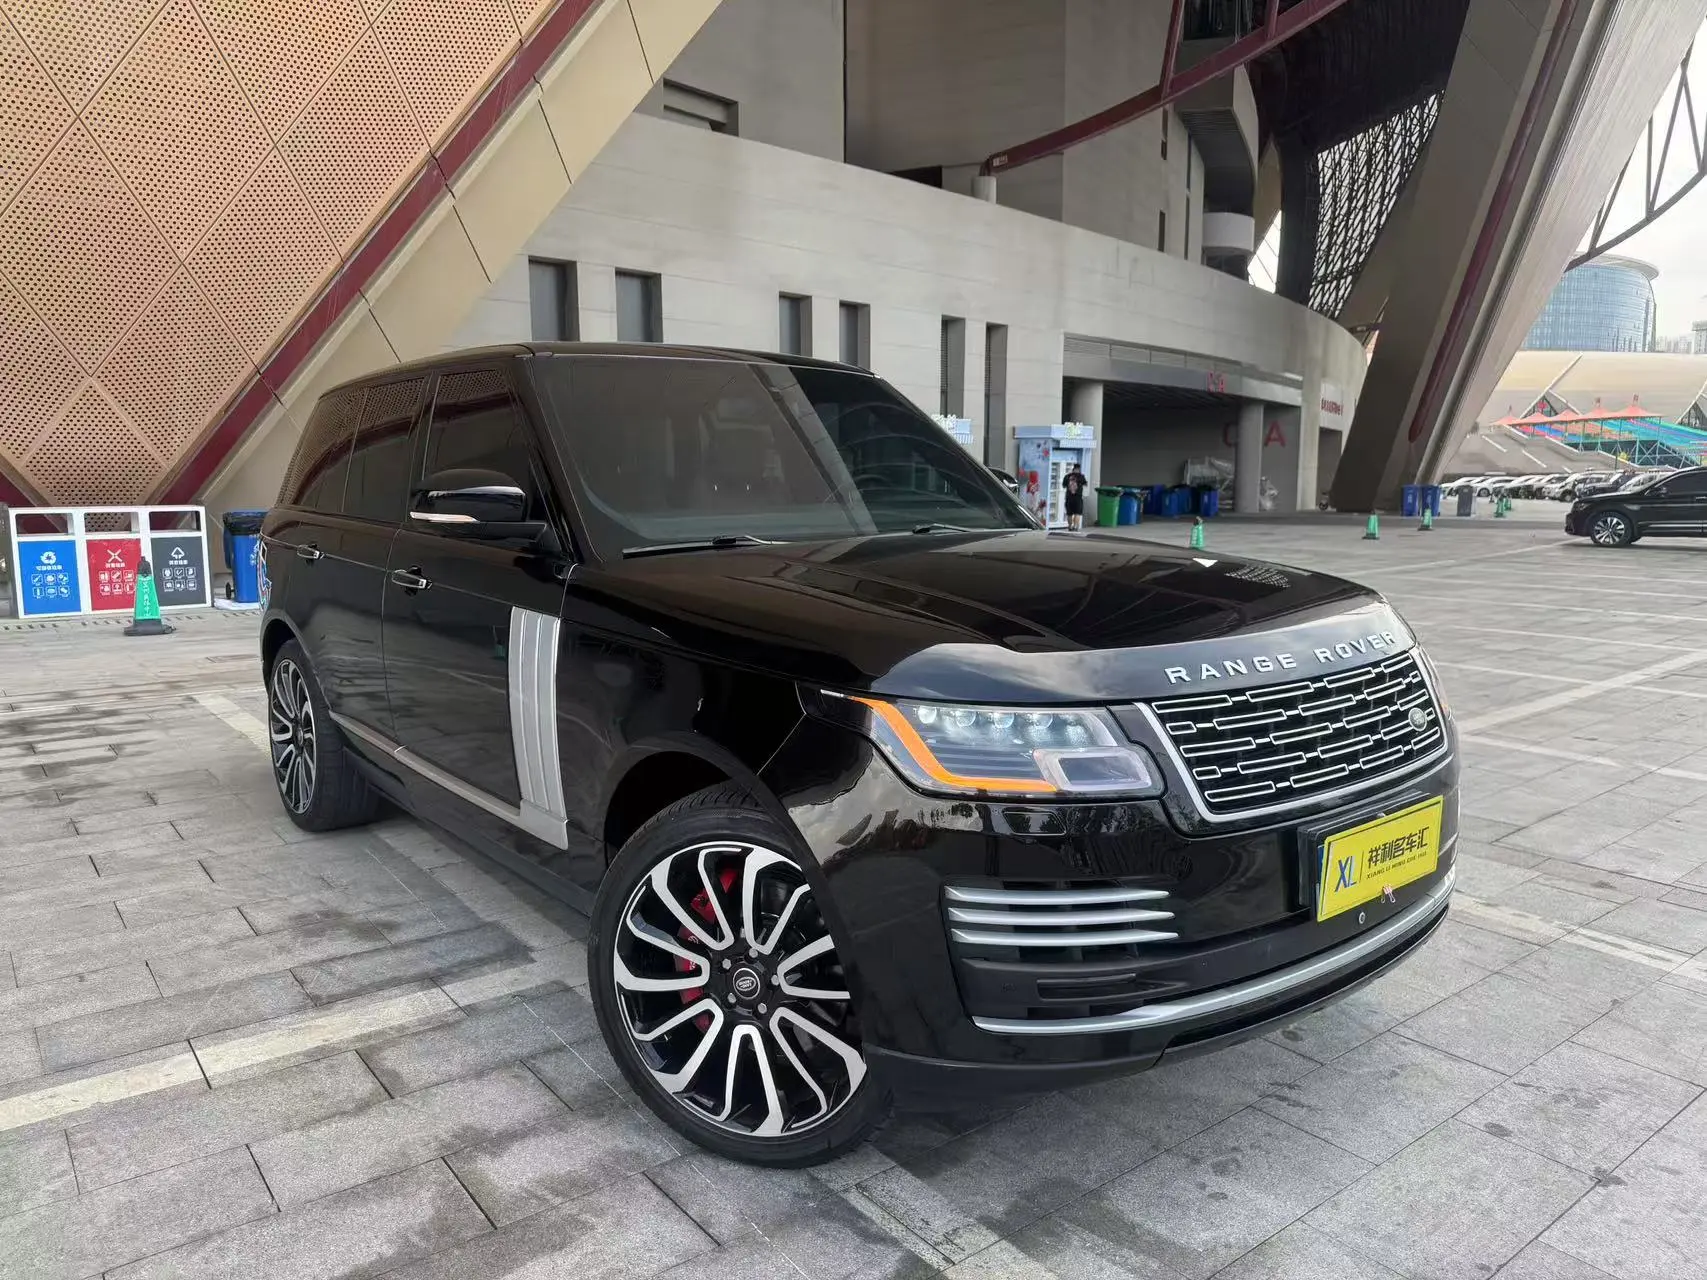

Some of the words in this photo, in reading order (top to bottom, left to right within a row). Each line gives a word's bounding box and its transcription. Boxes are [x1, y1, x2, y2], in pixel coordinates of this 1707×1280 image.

[1164, 653, 1297, 684] RANGE
[1313, 631, 1396, 663] ROVER
[1367, 826, 1430, 869] 祥利名车汇
[1335, 855, 1357, 892] XL
[1366, 868, 1385, 880] XIANG
